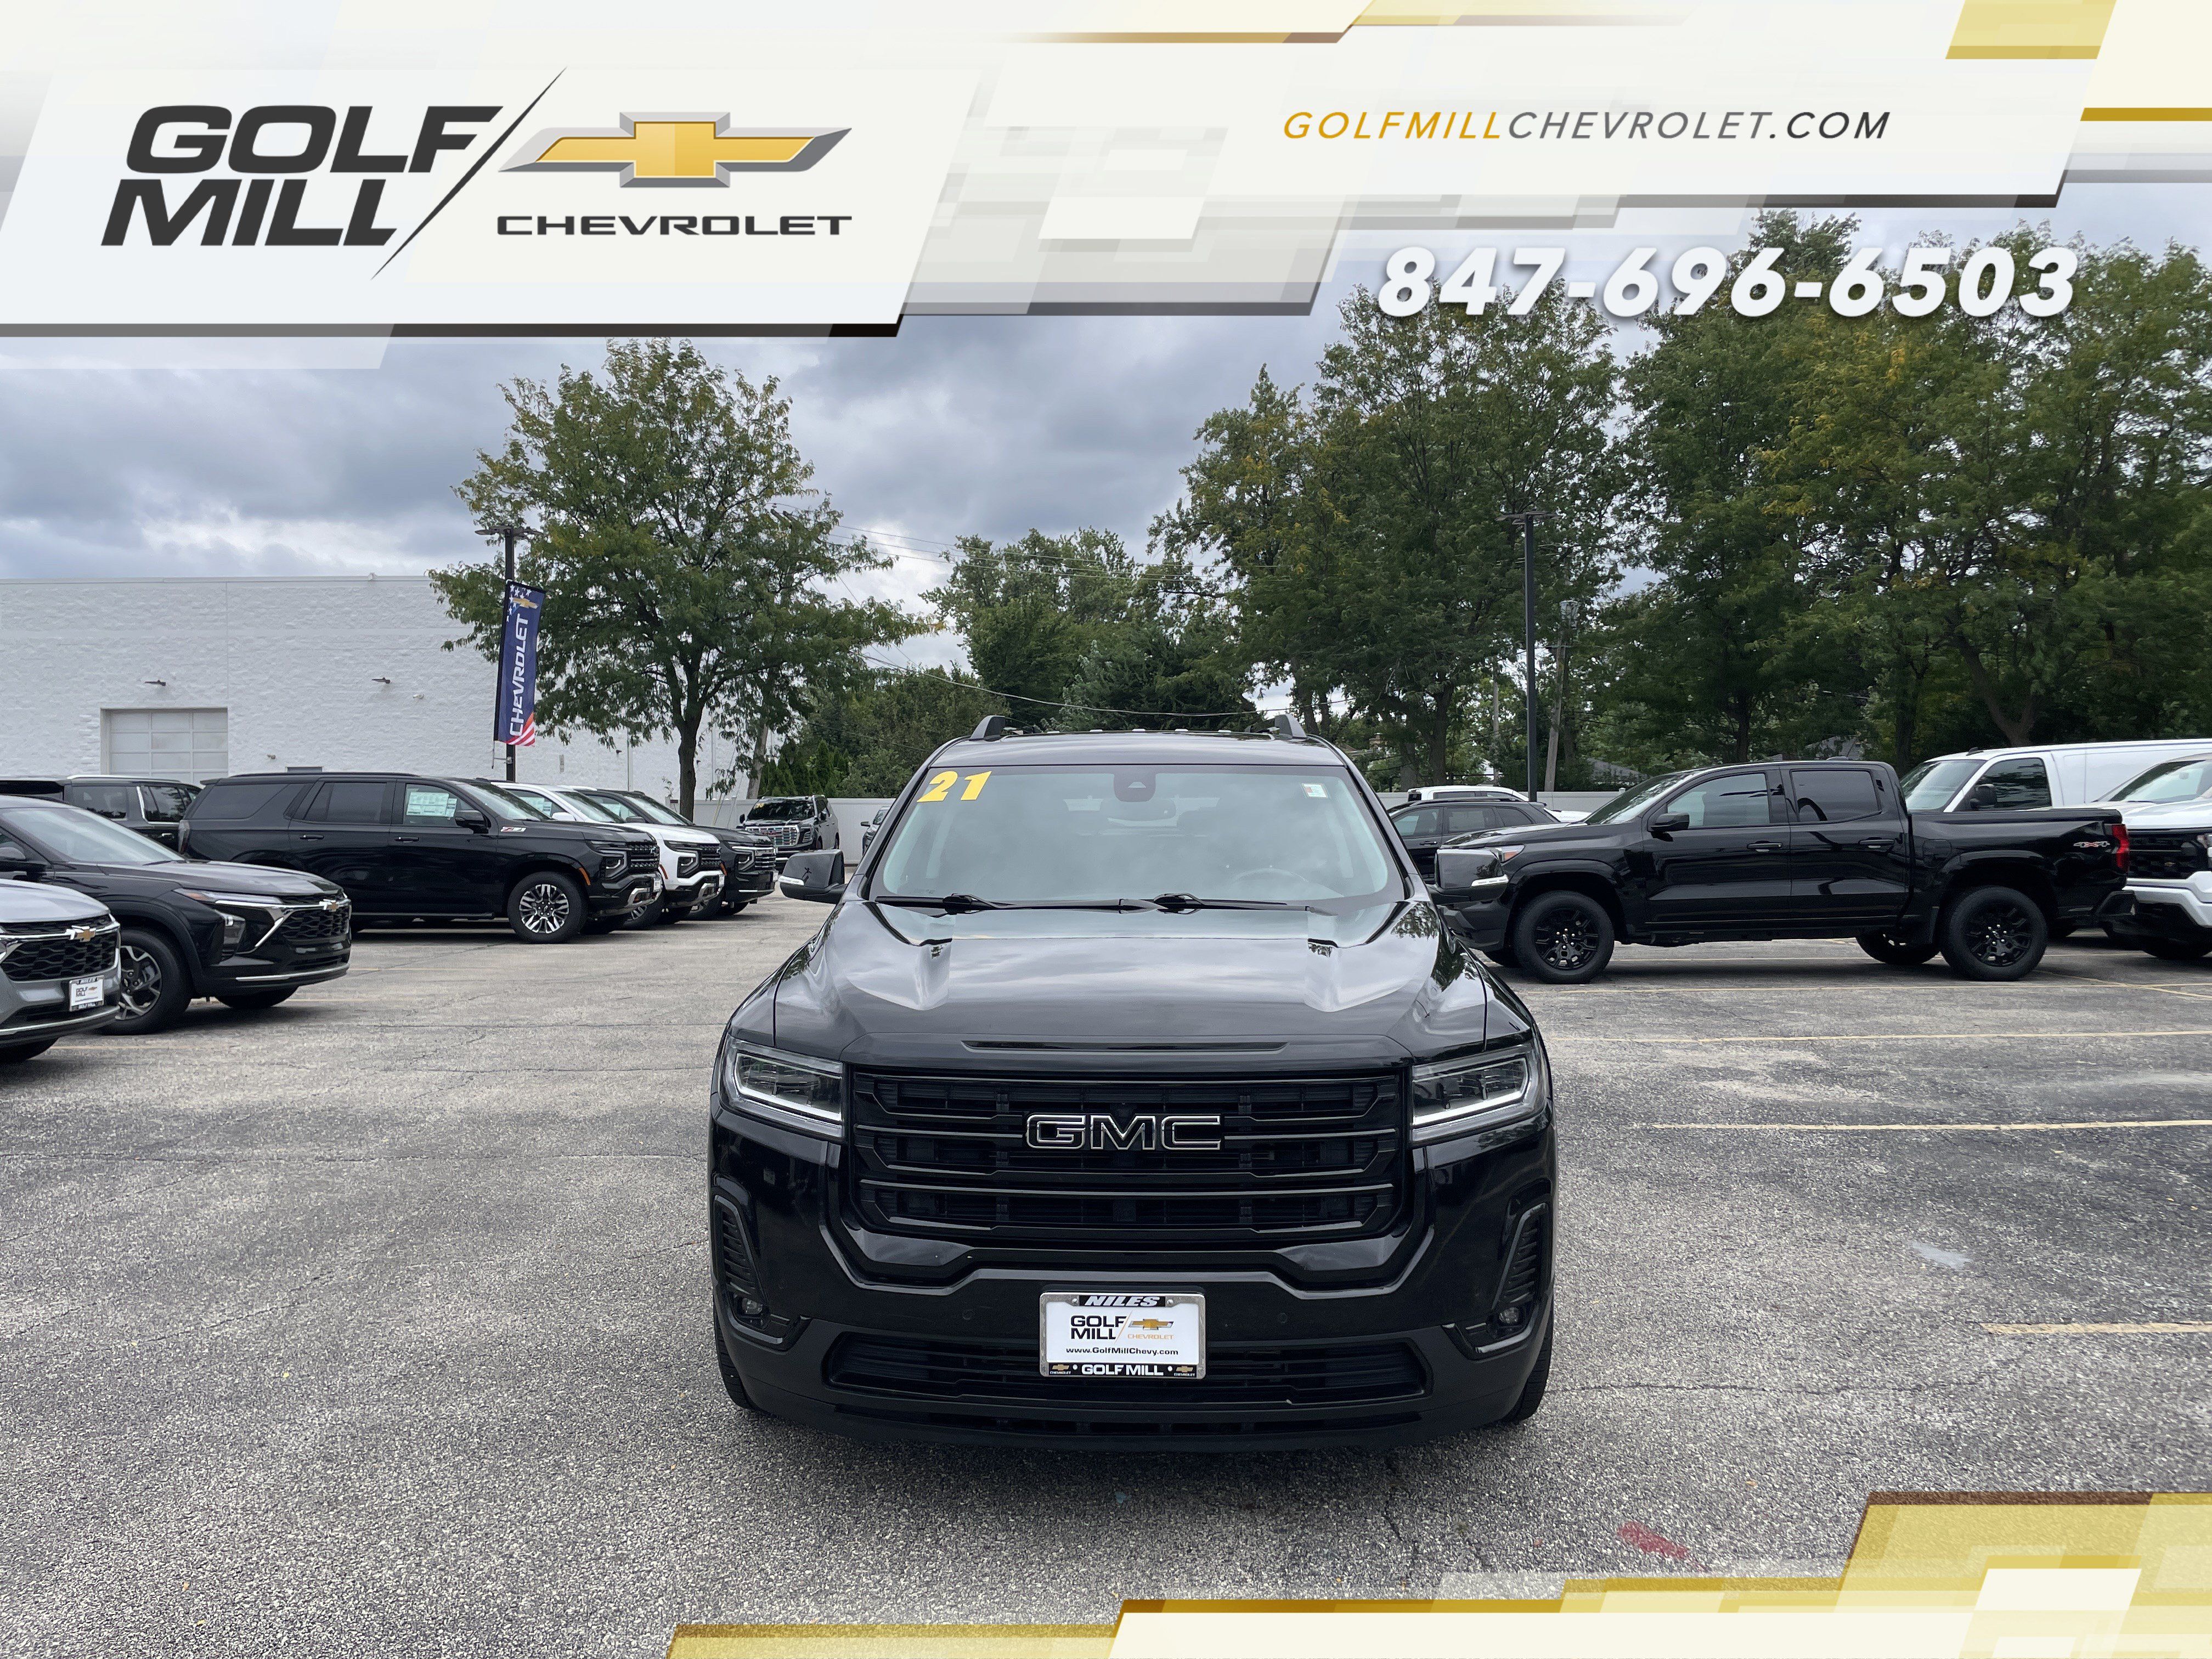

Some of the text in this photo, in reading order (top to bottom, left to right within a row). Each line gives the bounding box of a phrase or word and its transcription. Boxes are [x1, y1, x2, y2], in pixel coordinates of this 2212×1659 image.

[510, 613, 528, 736] CHEVROLET
[917, 771, 992, 802] 21
[1026, 1114, 1221, 1150] GMC
[1084, 1295, 1161, 1307] NILES
[1070, 1315, 1127, 1328] GOLF
[1071, 1328, 1116, 1340] MILL
[1066, 1347, 1178, 1356] www.GolfMillChevy.com
[1081, 1364, 1164, 1376] GOLF MILL
